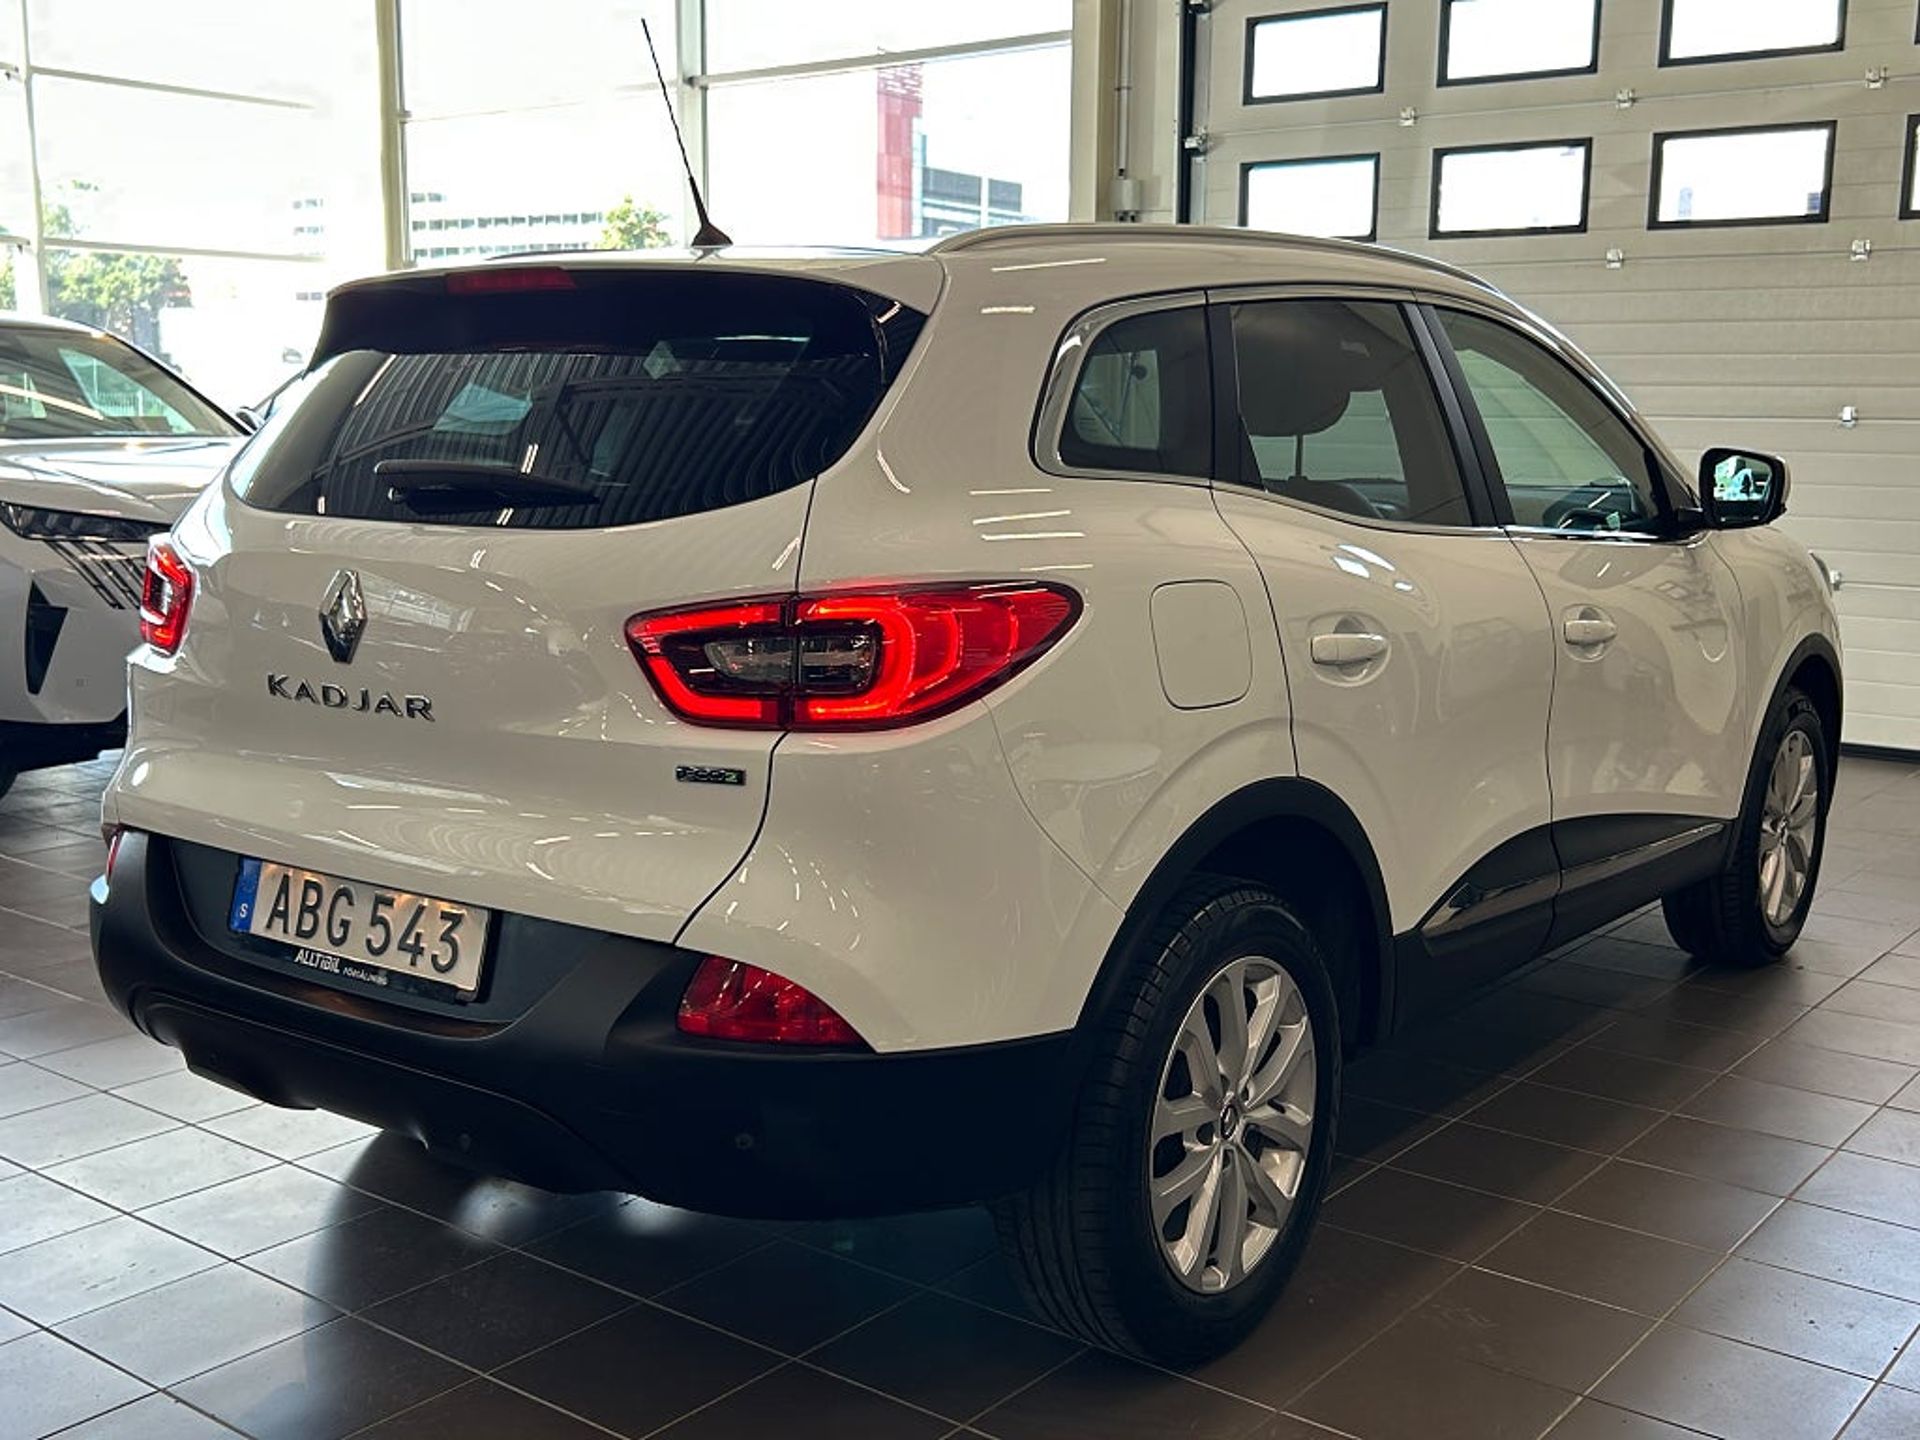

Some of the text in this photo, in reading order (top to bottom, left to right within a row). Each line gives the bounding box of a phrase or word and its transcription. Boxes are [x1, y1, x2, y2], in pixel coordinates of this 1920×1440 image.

[267, 672, 435, 722] KADJAR
[239, 903, 248, 918] S
[265, 873, 466, 974] ABG 543
